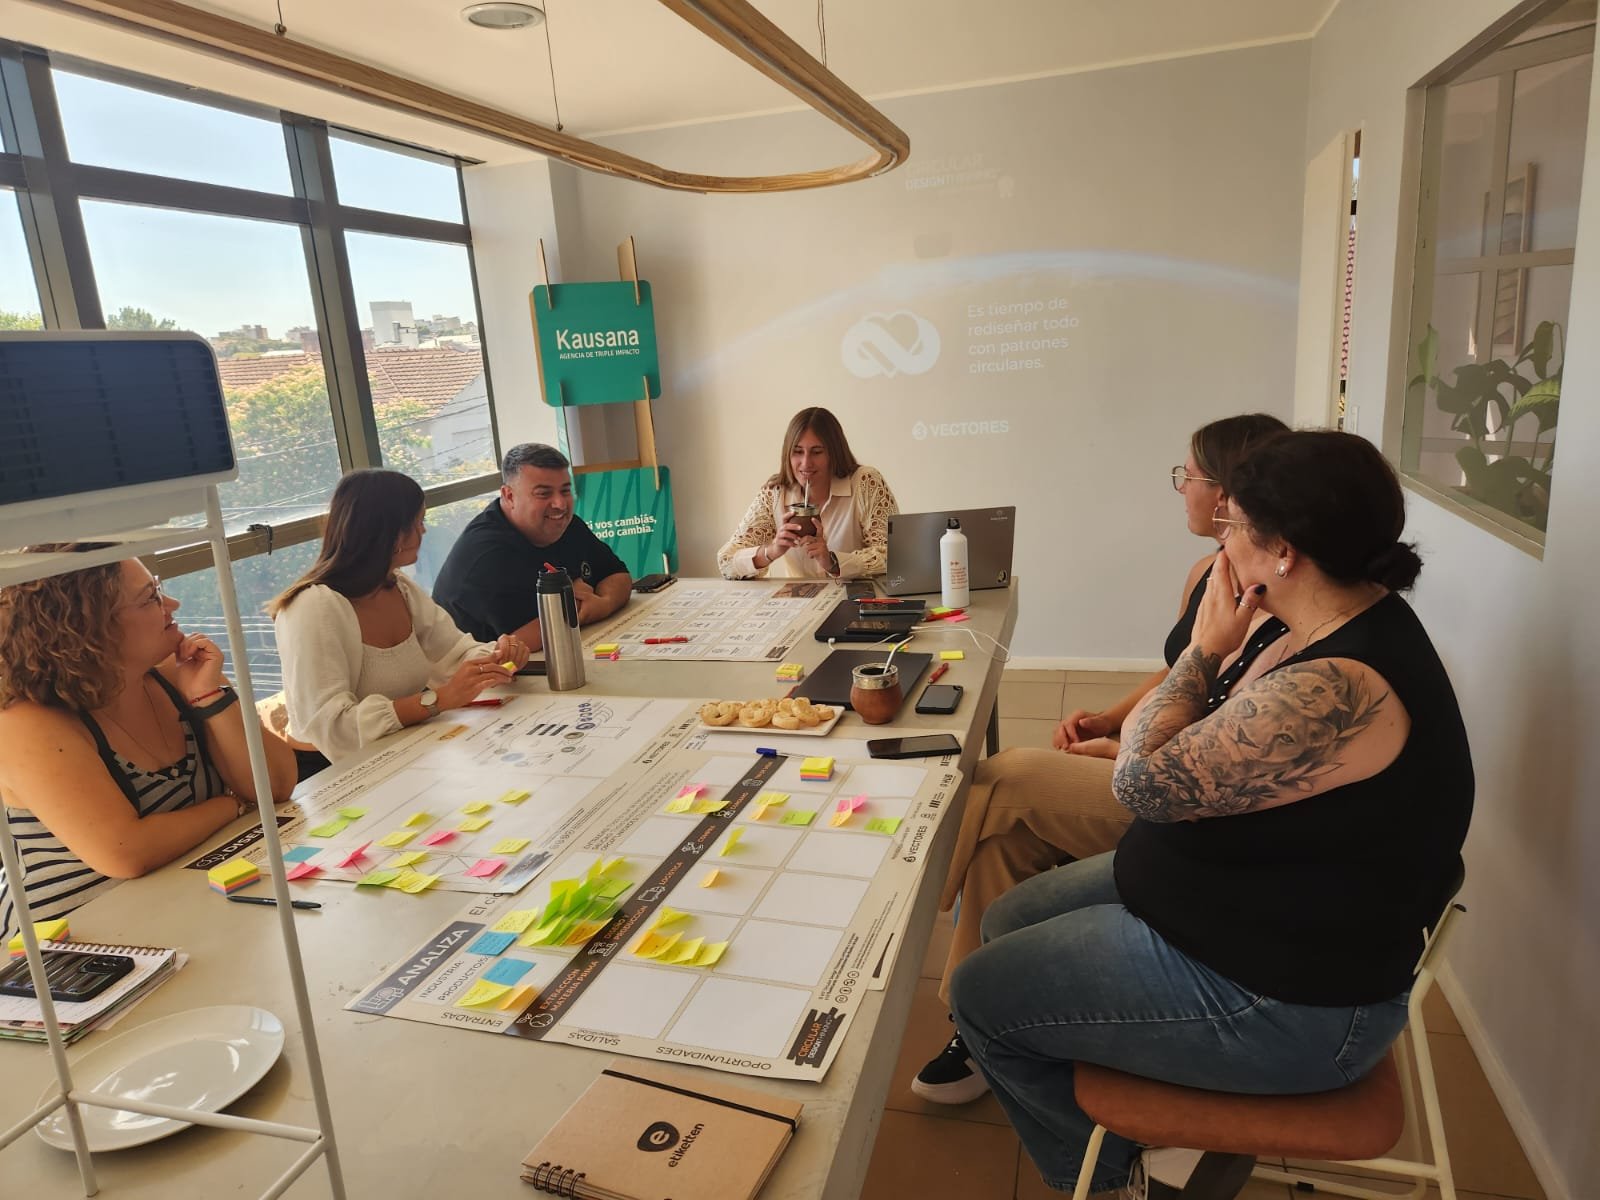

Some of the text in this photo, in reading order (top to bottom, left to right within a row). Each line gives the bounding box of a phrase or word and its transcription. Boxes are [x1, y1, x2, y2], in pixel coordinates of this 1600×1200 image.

[967, 297, 1068, 318] Es tiempo de
[968, 315, 1079, 336] rediseñar todo
[556, 329, 640, 350] Kausana
[969, 337, 1070, 356] con patrones
[595, 350, 614, 358] TRIPLE
[930, 420, 1009, 437] VECTORES
[594, 524, 654, 539] odo cambia.
[595, 521, 613, 529] vos
[614, 514, 657, 527] cambiás,
[909, 825, 928, 855] VECTORES
[469, 905, 488, 916] El
[398, 929, 470, 986] ANALIZA
[550, 960, 600, 1012] MATERIA PRIMA
[441, 1011, 503, 1027] ENTRADAS
[568, 1031, 621, 1046] SALIDAS
[798, 1022, 822, 1057] CIRCULAR
[656, 1046, 772, 1071] OPORTUNIDADES
[668, 1123, 705, 1168] etiketten
